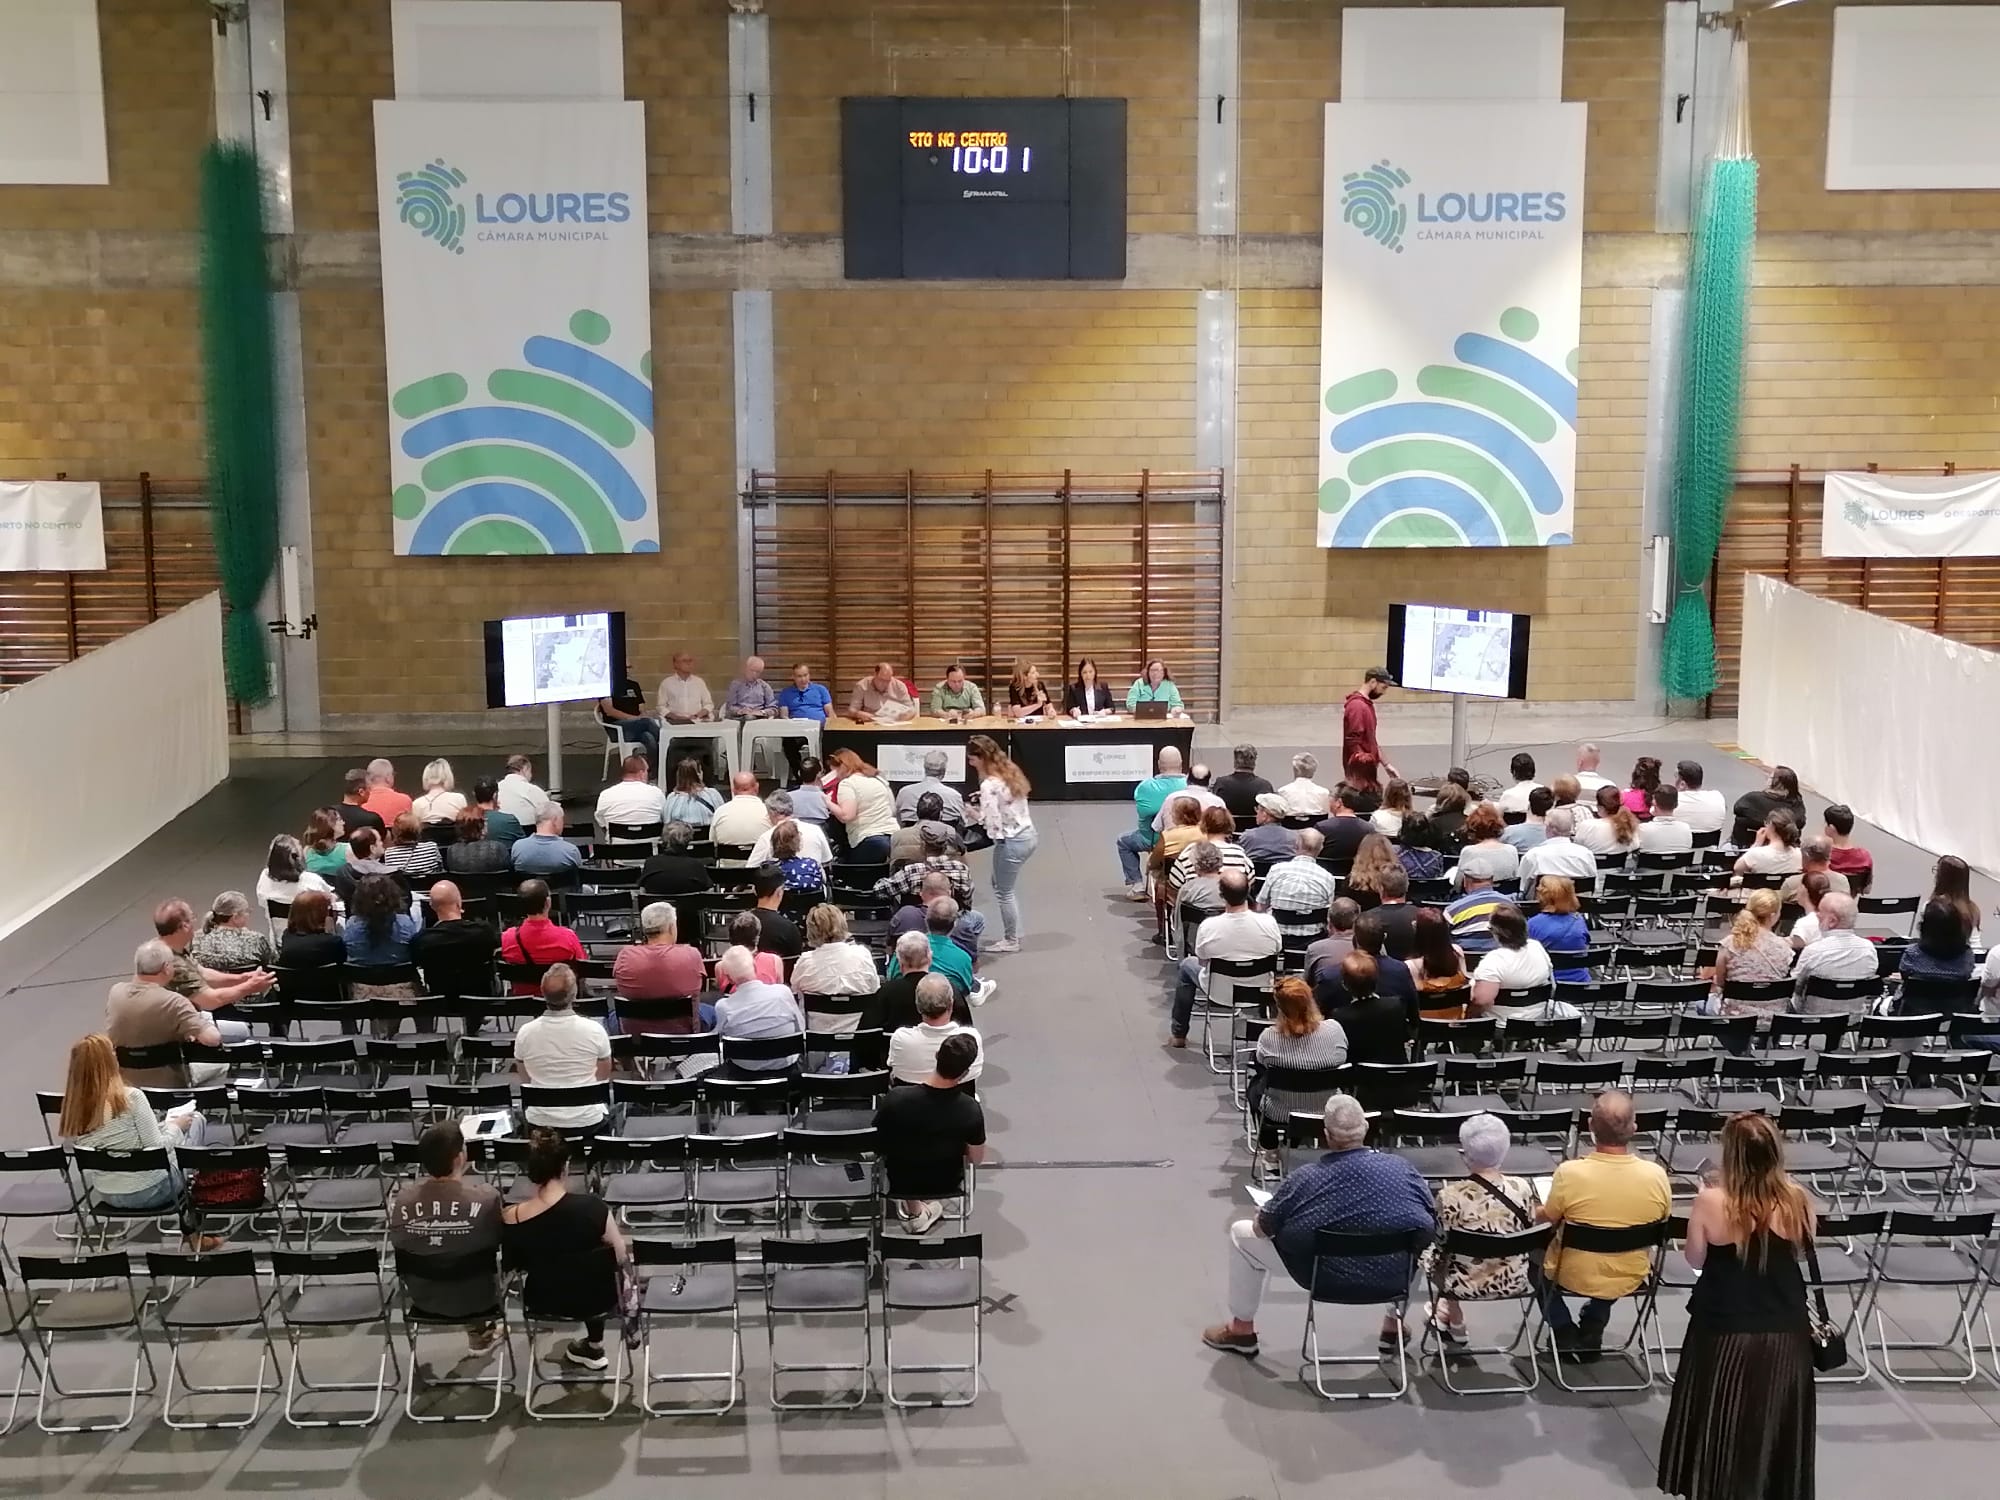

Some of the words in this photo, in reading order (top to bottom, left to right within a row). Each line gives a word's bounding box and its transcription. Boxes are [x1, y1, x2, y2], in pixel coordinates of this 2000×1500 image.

[937, 132, 956, 148] NO
[960, 132, 1008, 148] CENTRO
[476, 192, 630, 224] LOURES
[1417, 192, 1566, 223] LOURES
[477, 229, 535, 241] CÂMARA
[537, 231, 609, 241] MUNICIPAL
[1417, 229, 1472, 241] CÂMARA
[1475, 230, 1545, 241] MUNICIPAL
[1871, 509, 1925, 521] LOURES
[24, 521, 40, 529] NO
[42, 521, 82, 529] CENTRO
[400, 1200, 482, 1220] SCREW
